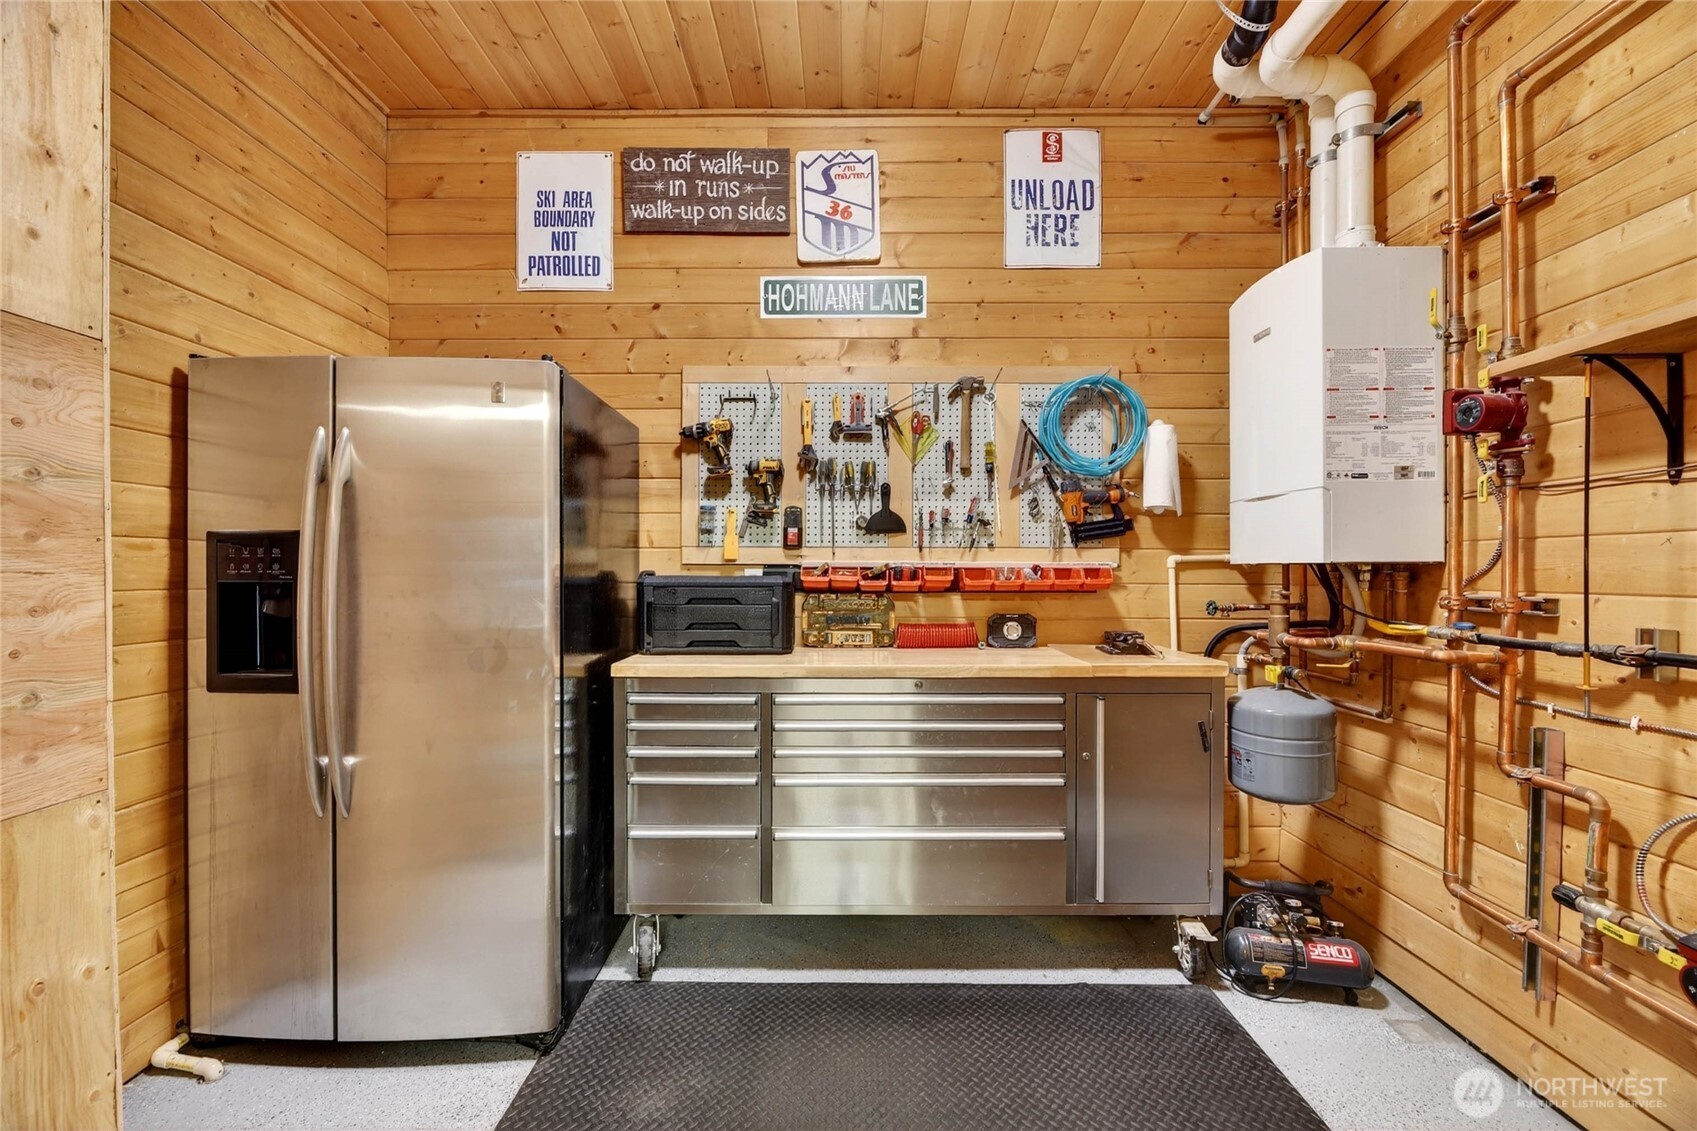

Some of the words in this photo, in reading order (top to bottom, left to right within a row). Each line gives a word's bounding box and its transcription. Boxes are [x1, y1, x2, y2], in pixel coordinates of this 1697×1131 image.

[630, 151, 656, 172] do
[663, 151, 697, 173] not
[700, 150, 780, 179] walk-up
[669, 179, 687, 197] in
[695, 179, 740, 198] runs
[1011, 179, 1095, 211] UNLOAD
[536, 190, 556, 208] SKI
[562, 190, 593, 209] AREA
[825, 200, 853, 220] 36
[533, 210, 595, 228] BOUNDARY
[630, 199, 705, 226] walk-up
[709, 205, 732, 220] on
[737, 196, 787, 222] sides
[1026, 213, 1080, 247] HERE
[551, 231, 578, 252] NOT
[528, 255, 601, 277] PATROLLED
[768, 283, 864, 312] HOHMANN
[869, 283, 919, 312] LANE
[1308, 943, 1353, 960] SENCO
